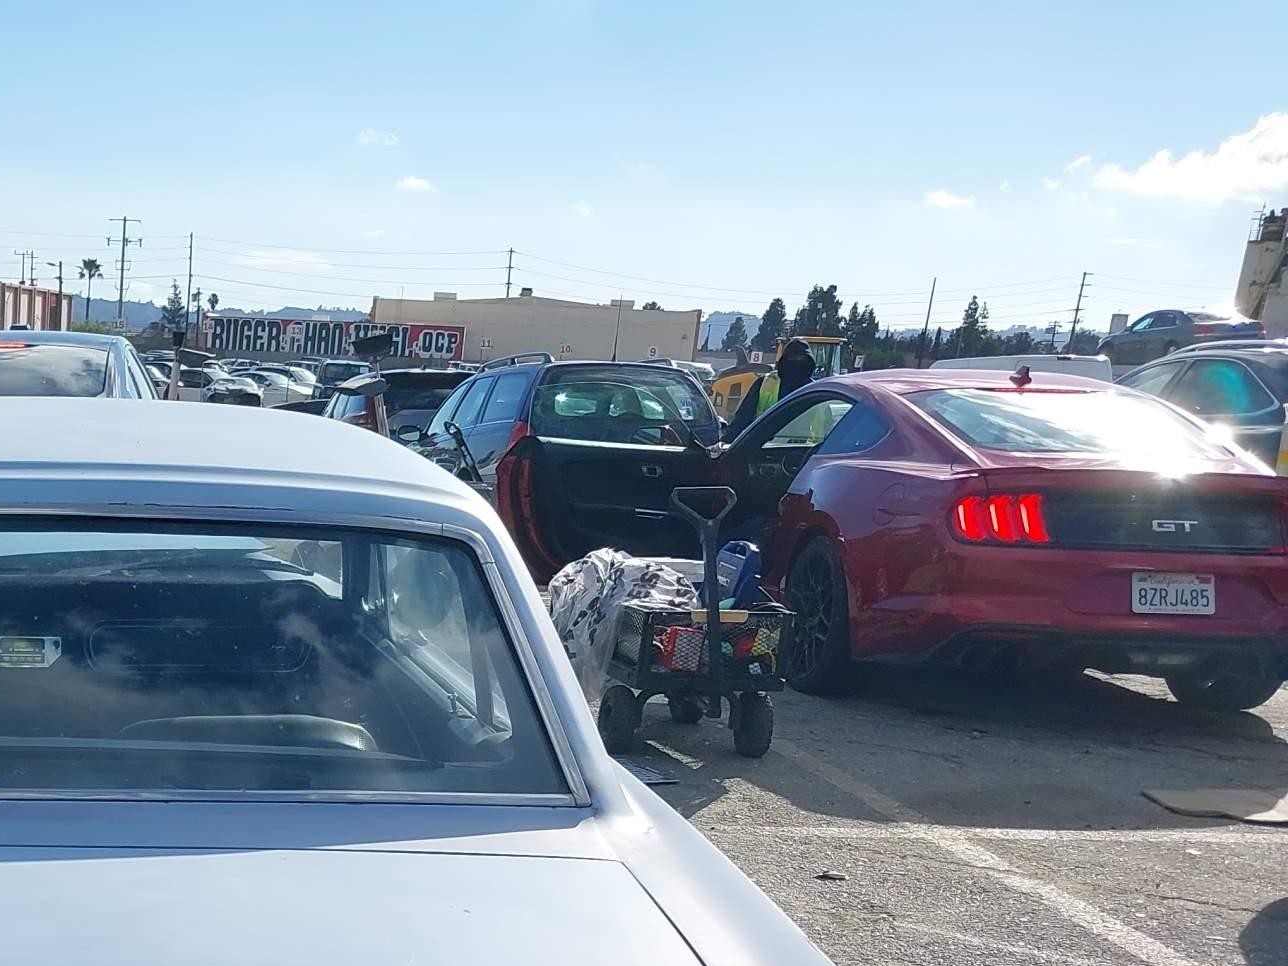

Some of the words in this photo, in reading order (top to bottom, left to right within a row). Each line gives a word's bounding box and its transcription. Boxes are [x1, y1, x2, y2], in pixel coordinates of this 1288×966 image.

[114, 320, 124, 329] 15
[1151, 519, 1199, 532] GT
[1138, 587, 1210, 607] 8ZRJ485
